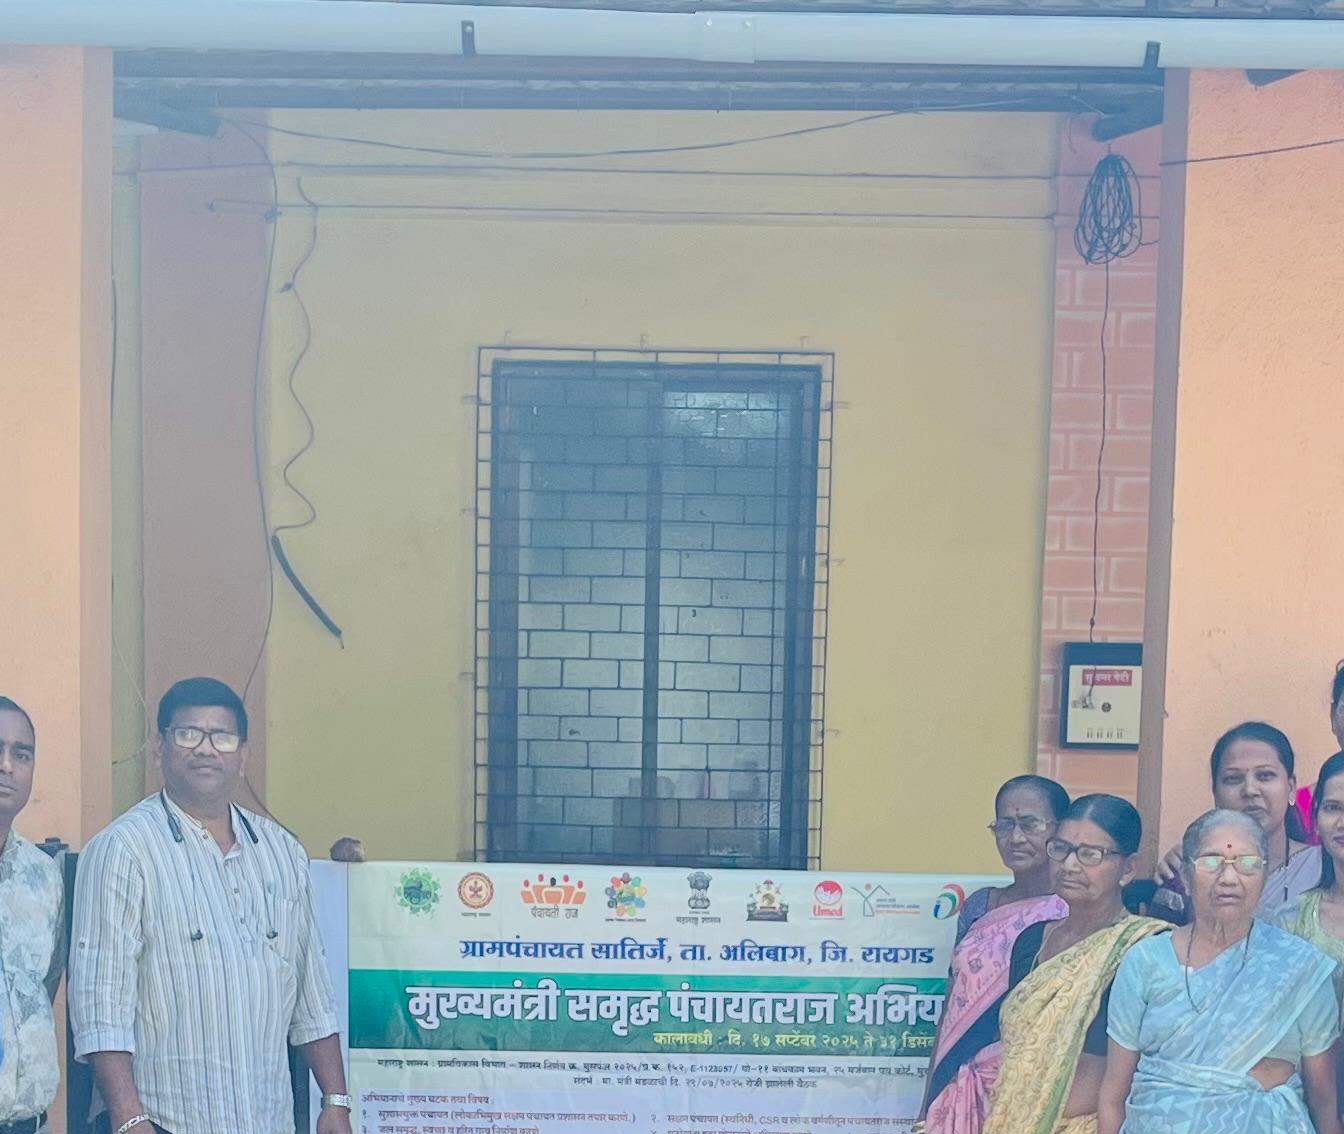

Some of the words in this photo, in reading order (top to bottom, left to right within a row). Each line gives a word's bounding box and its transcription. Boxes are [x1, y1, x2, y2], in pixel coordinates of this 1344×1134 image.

[813, 905, 843, 917] Umed
[459, 935, 584, 960] ग्रामपंचायत
[591, 937, 672, 963] सातिर्जे,
[680, 943, 712, 961] ता.
[719, 939, 812, 965] अलिबाग,
[820, 940, 853, 963] जि.
[861, 946, 935, 964] रायगड
[405, 977, 560, 1030] मुख्यमंत्री
[564, 988, 662, 1037] समृद्ध
[666, 981, 839, 1025] पंचायतराज
[846, 983, 945, 1026] अभिय
[653, 1030, 713, 1046] कालावधी
[728, 1030, 745, 1047] दि.
[863, 1031, 874, 1048] ते
